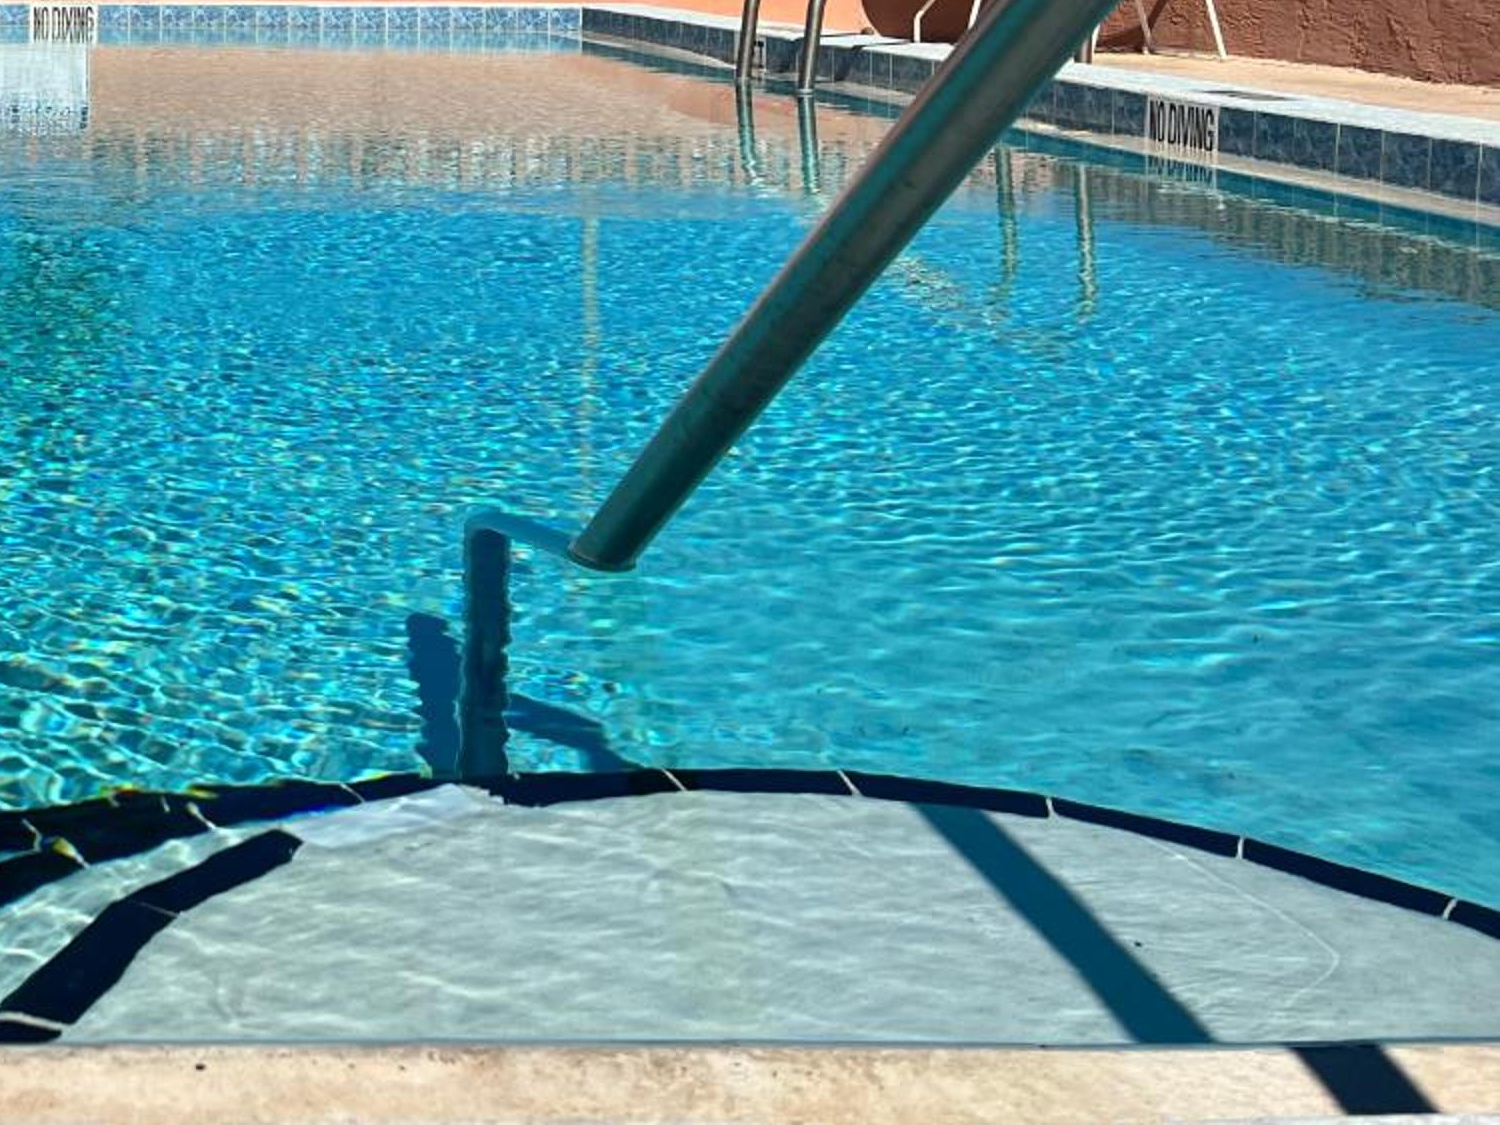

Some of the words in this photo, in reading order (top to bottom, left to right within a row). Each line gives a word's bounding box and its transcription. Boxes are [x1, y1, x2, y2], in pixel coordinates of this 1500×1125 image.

[33, 6, 49, 30] NO
[52, 6, 94, 30] DIVING
[1150, 100, 1165, 142] NO
[1167, 102, 1214, 151] DIVING
